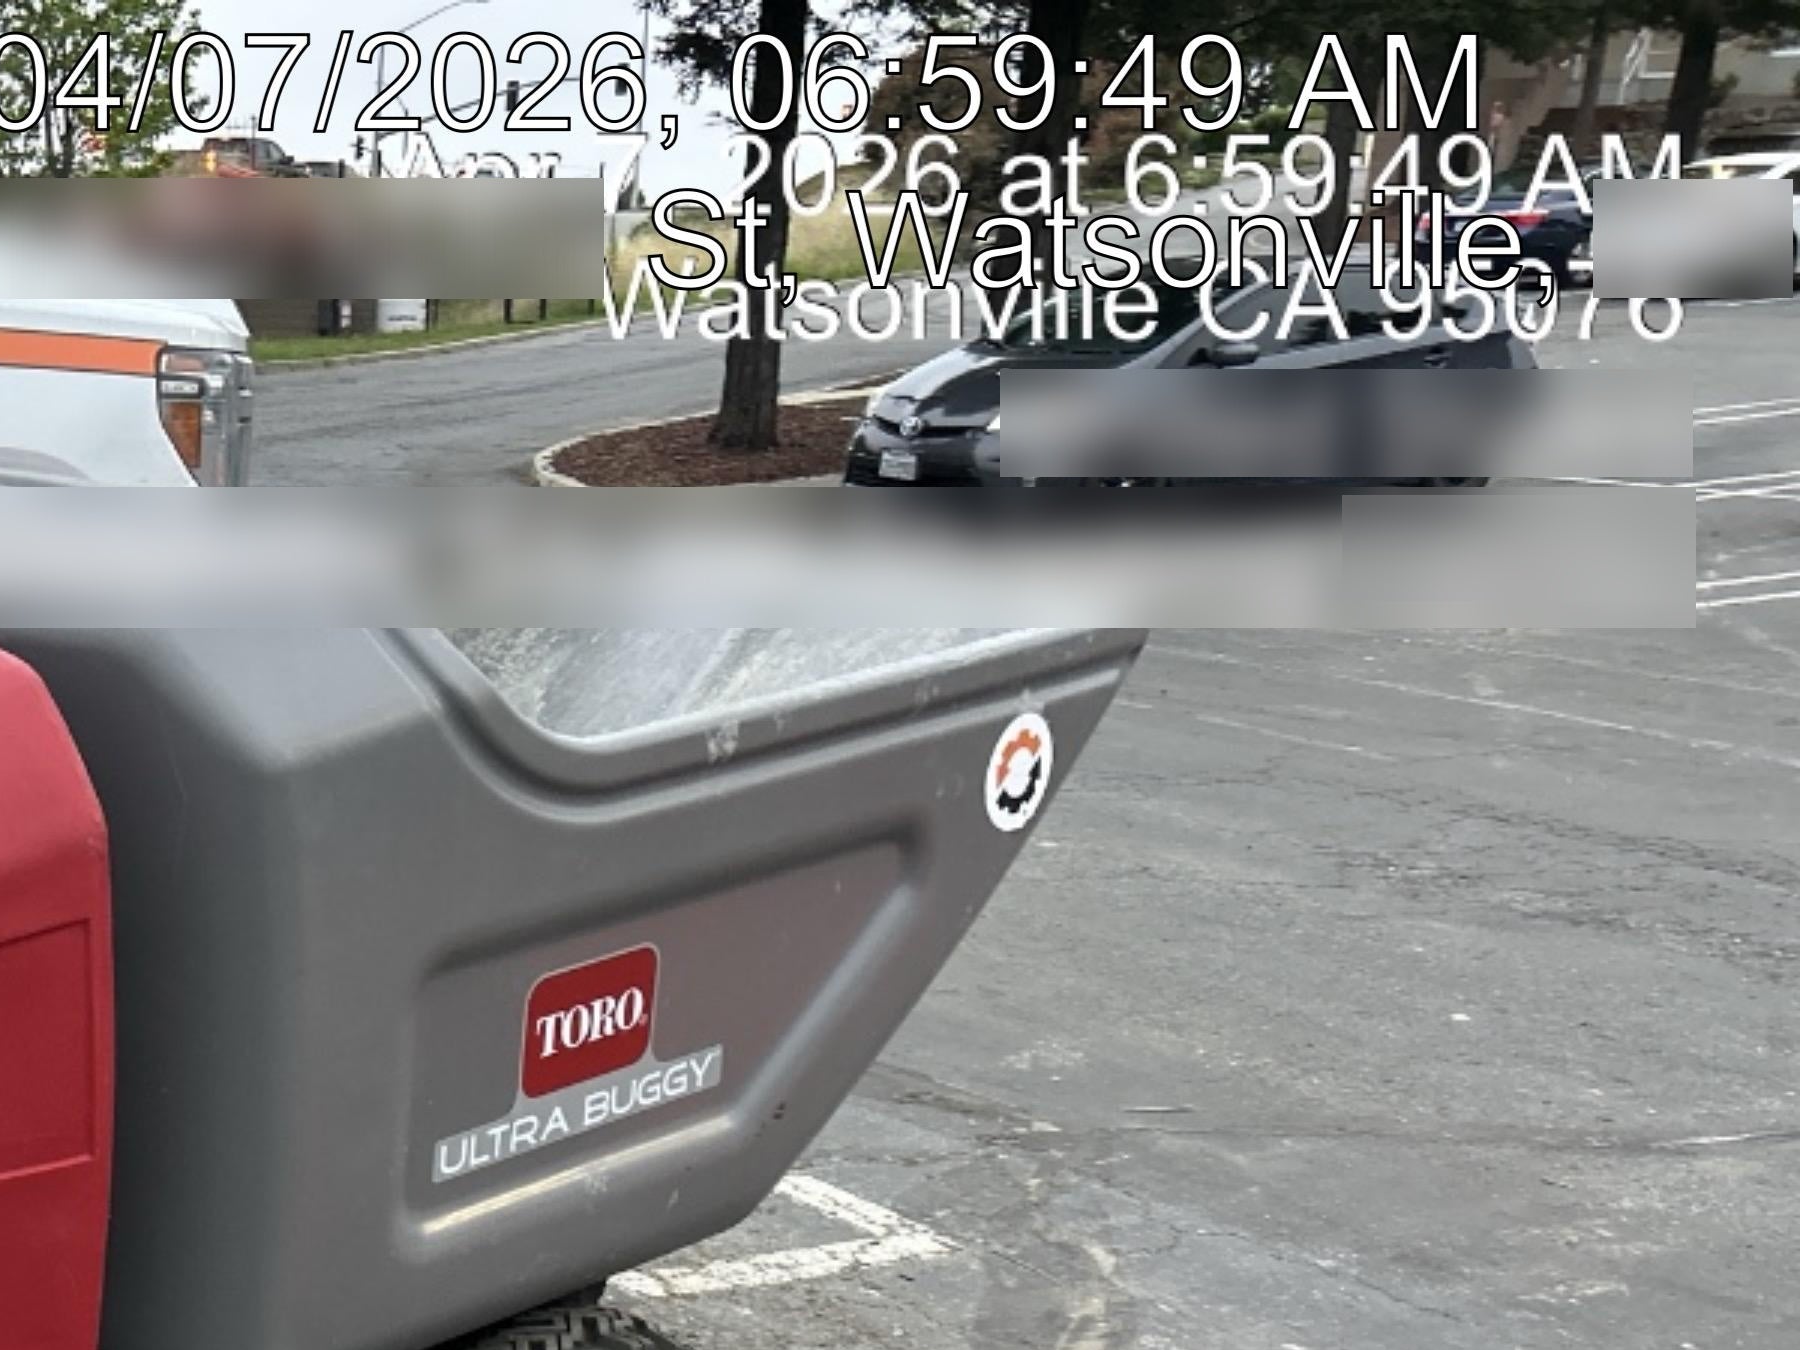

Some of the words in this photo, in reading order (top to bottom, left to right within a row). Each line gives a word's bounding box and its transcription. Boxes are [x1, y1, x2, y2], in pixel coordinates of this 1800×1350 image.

[535, 986, 644, 1059] TORO
[439, 1105, 569, 1174] ULTRA
[583, 1052, 716, 1126] BUGGY
